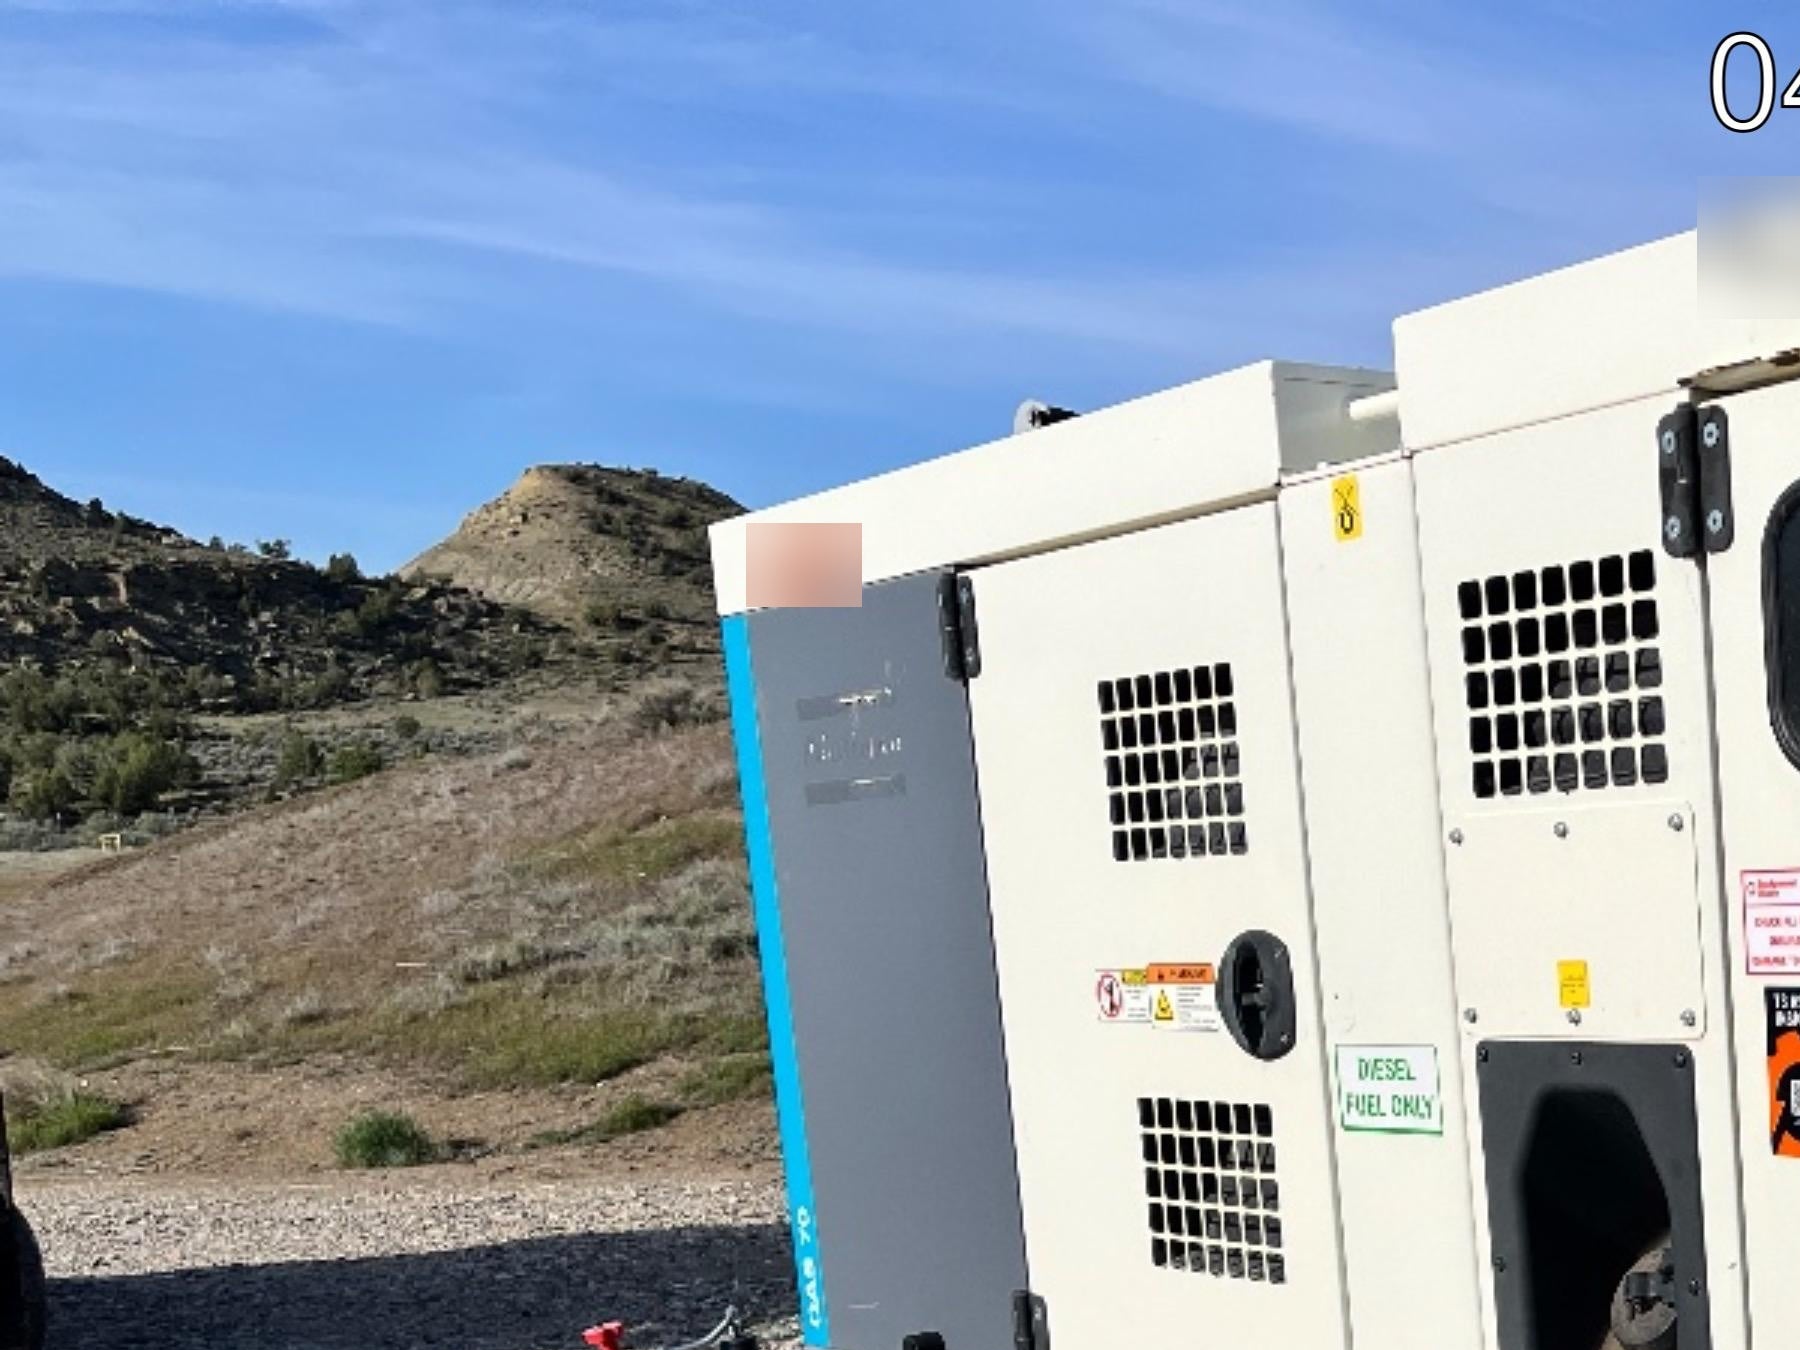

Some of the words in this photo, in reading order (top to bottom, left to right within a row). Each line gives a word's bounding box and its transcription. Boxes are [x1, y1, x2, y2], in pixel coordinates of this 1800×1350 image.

[1357, 1057, 1417, 1081] DIESEL
[1346, 1092, 1387, 1117] FUEL
[1391, 1094, 1435, 1119] ONLY
